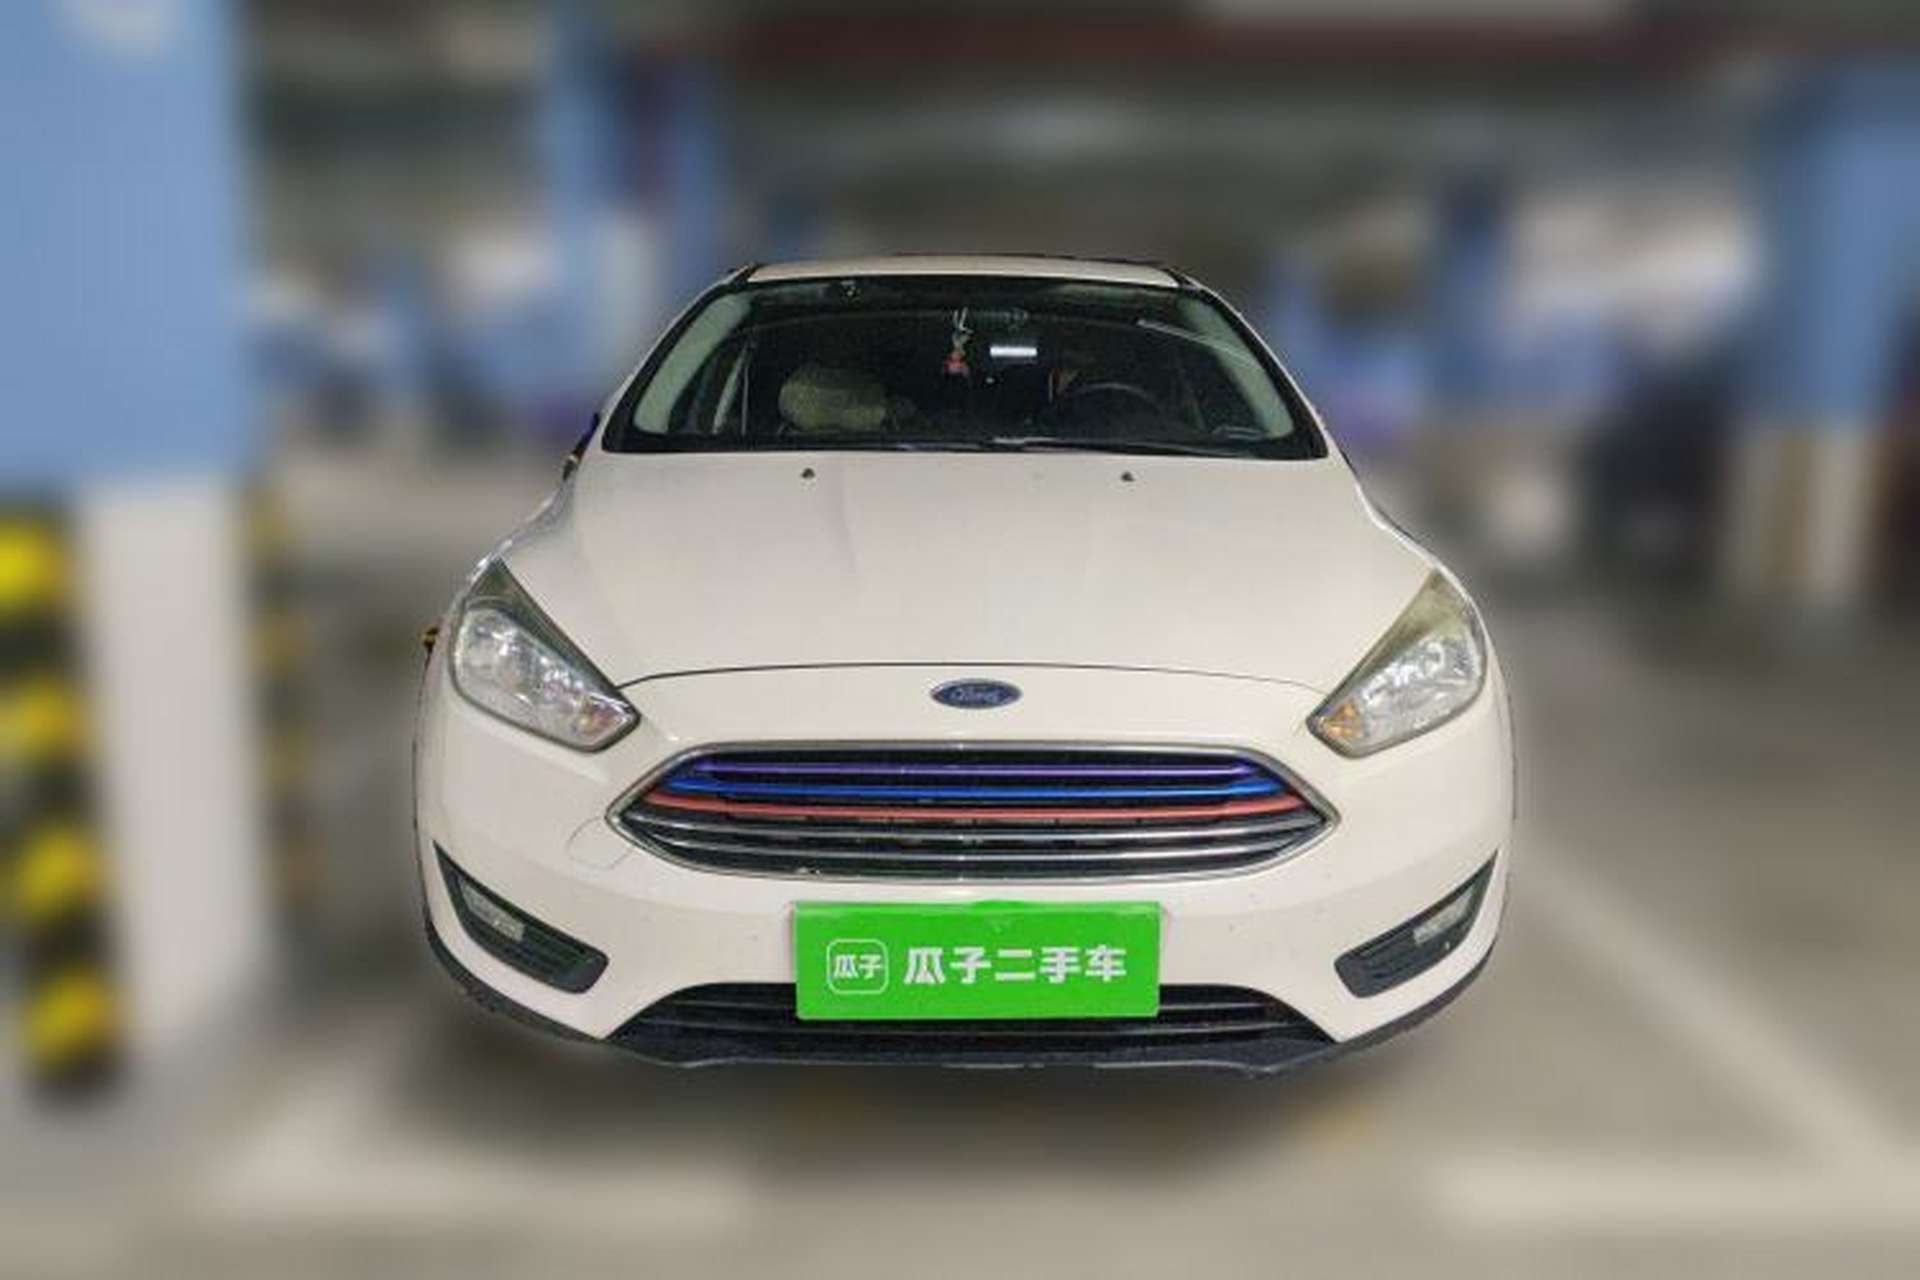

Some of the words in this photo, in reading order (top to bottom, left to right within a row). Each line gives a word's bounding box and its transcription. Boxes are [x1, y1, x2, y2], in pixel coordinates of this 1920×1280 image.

[832, 954, 882, 979] 瓜子
[903, 944, 1127, 984] 瓜子二手车
